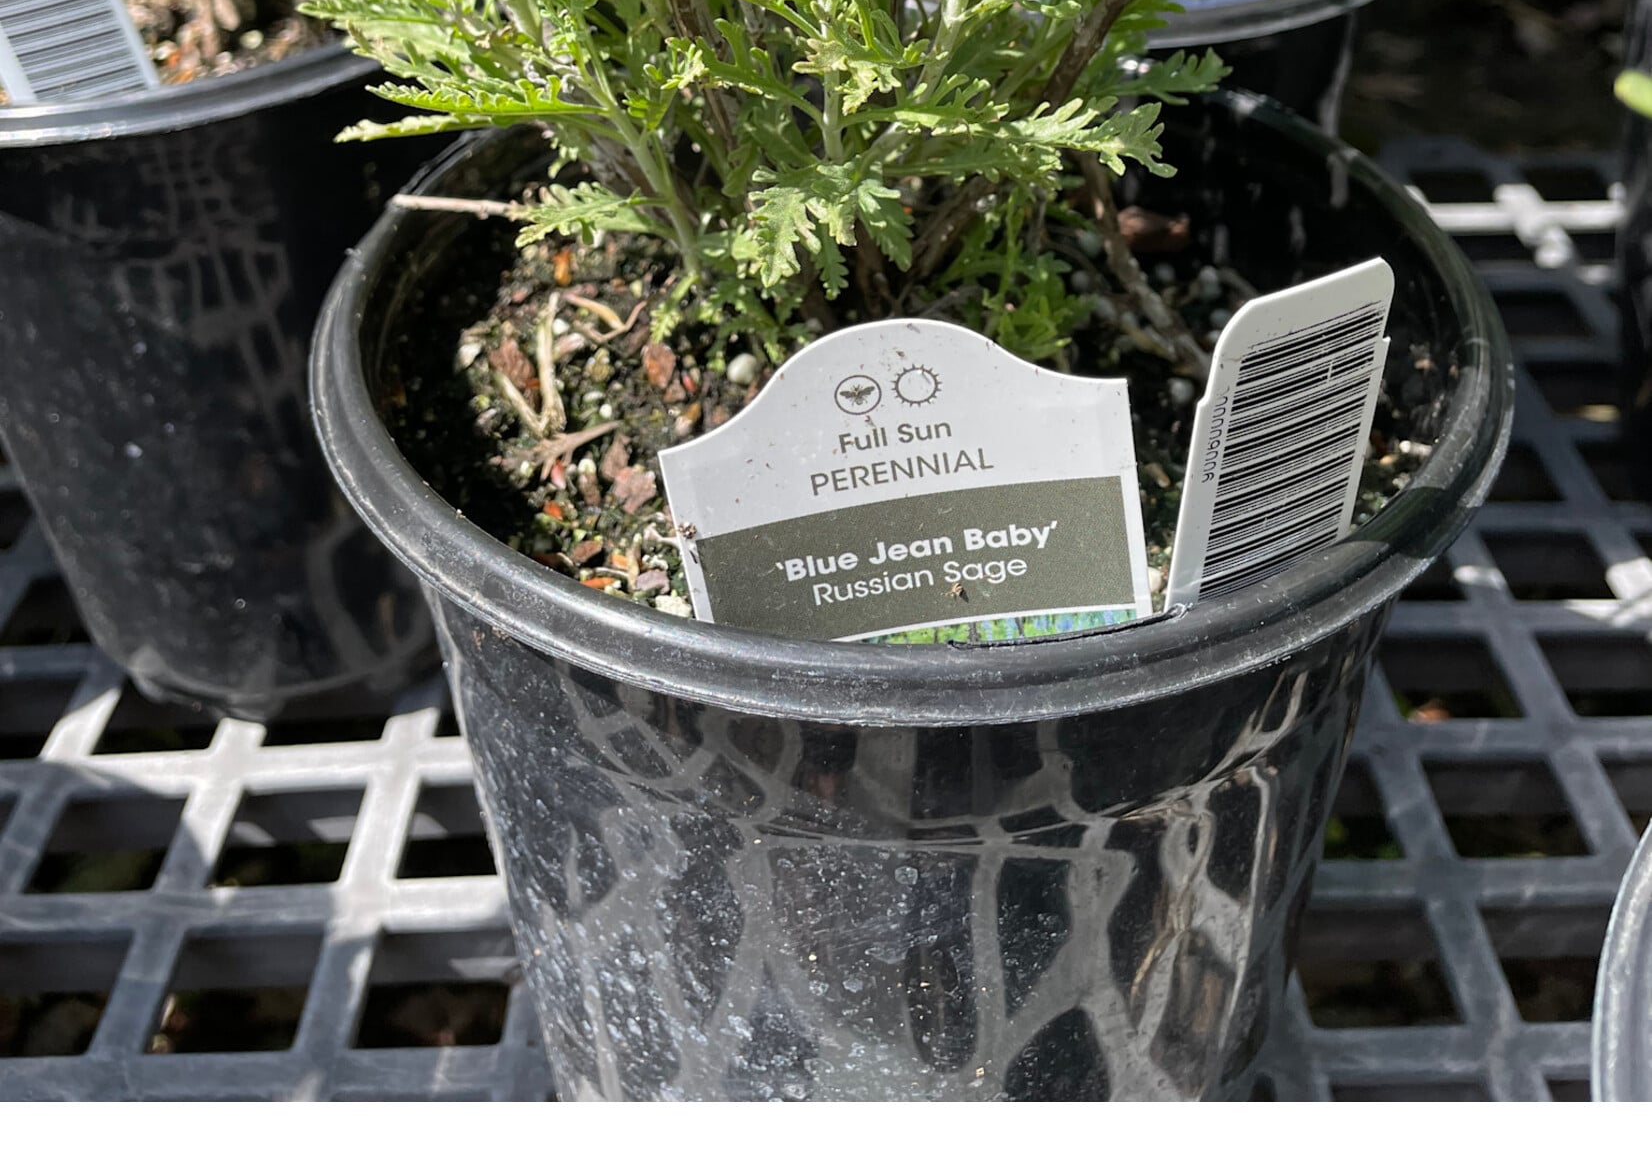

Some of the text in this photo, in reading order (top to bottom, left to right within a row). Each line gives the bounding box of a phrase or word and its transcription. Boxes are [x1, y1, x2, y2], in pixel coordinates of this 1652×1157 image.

[838, 422, 952, 454] Full Sun
[809, 447, 994, 496] PERENNIAL
[868, 536, 953, 565] Jean
[812, 558, 1028, 606] Russian Sage
